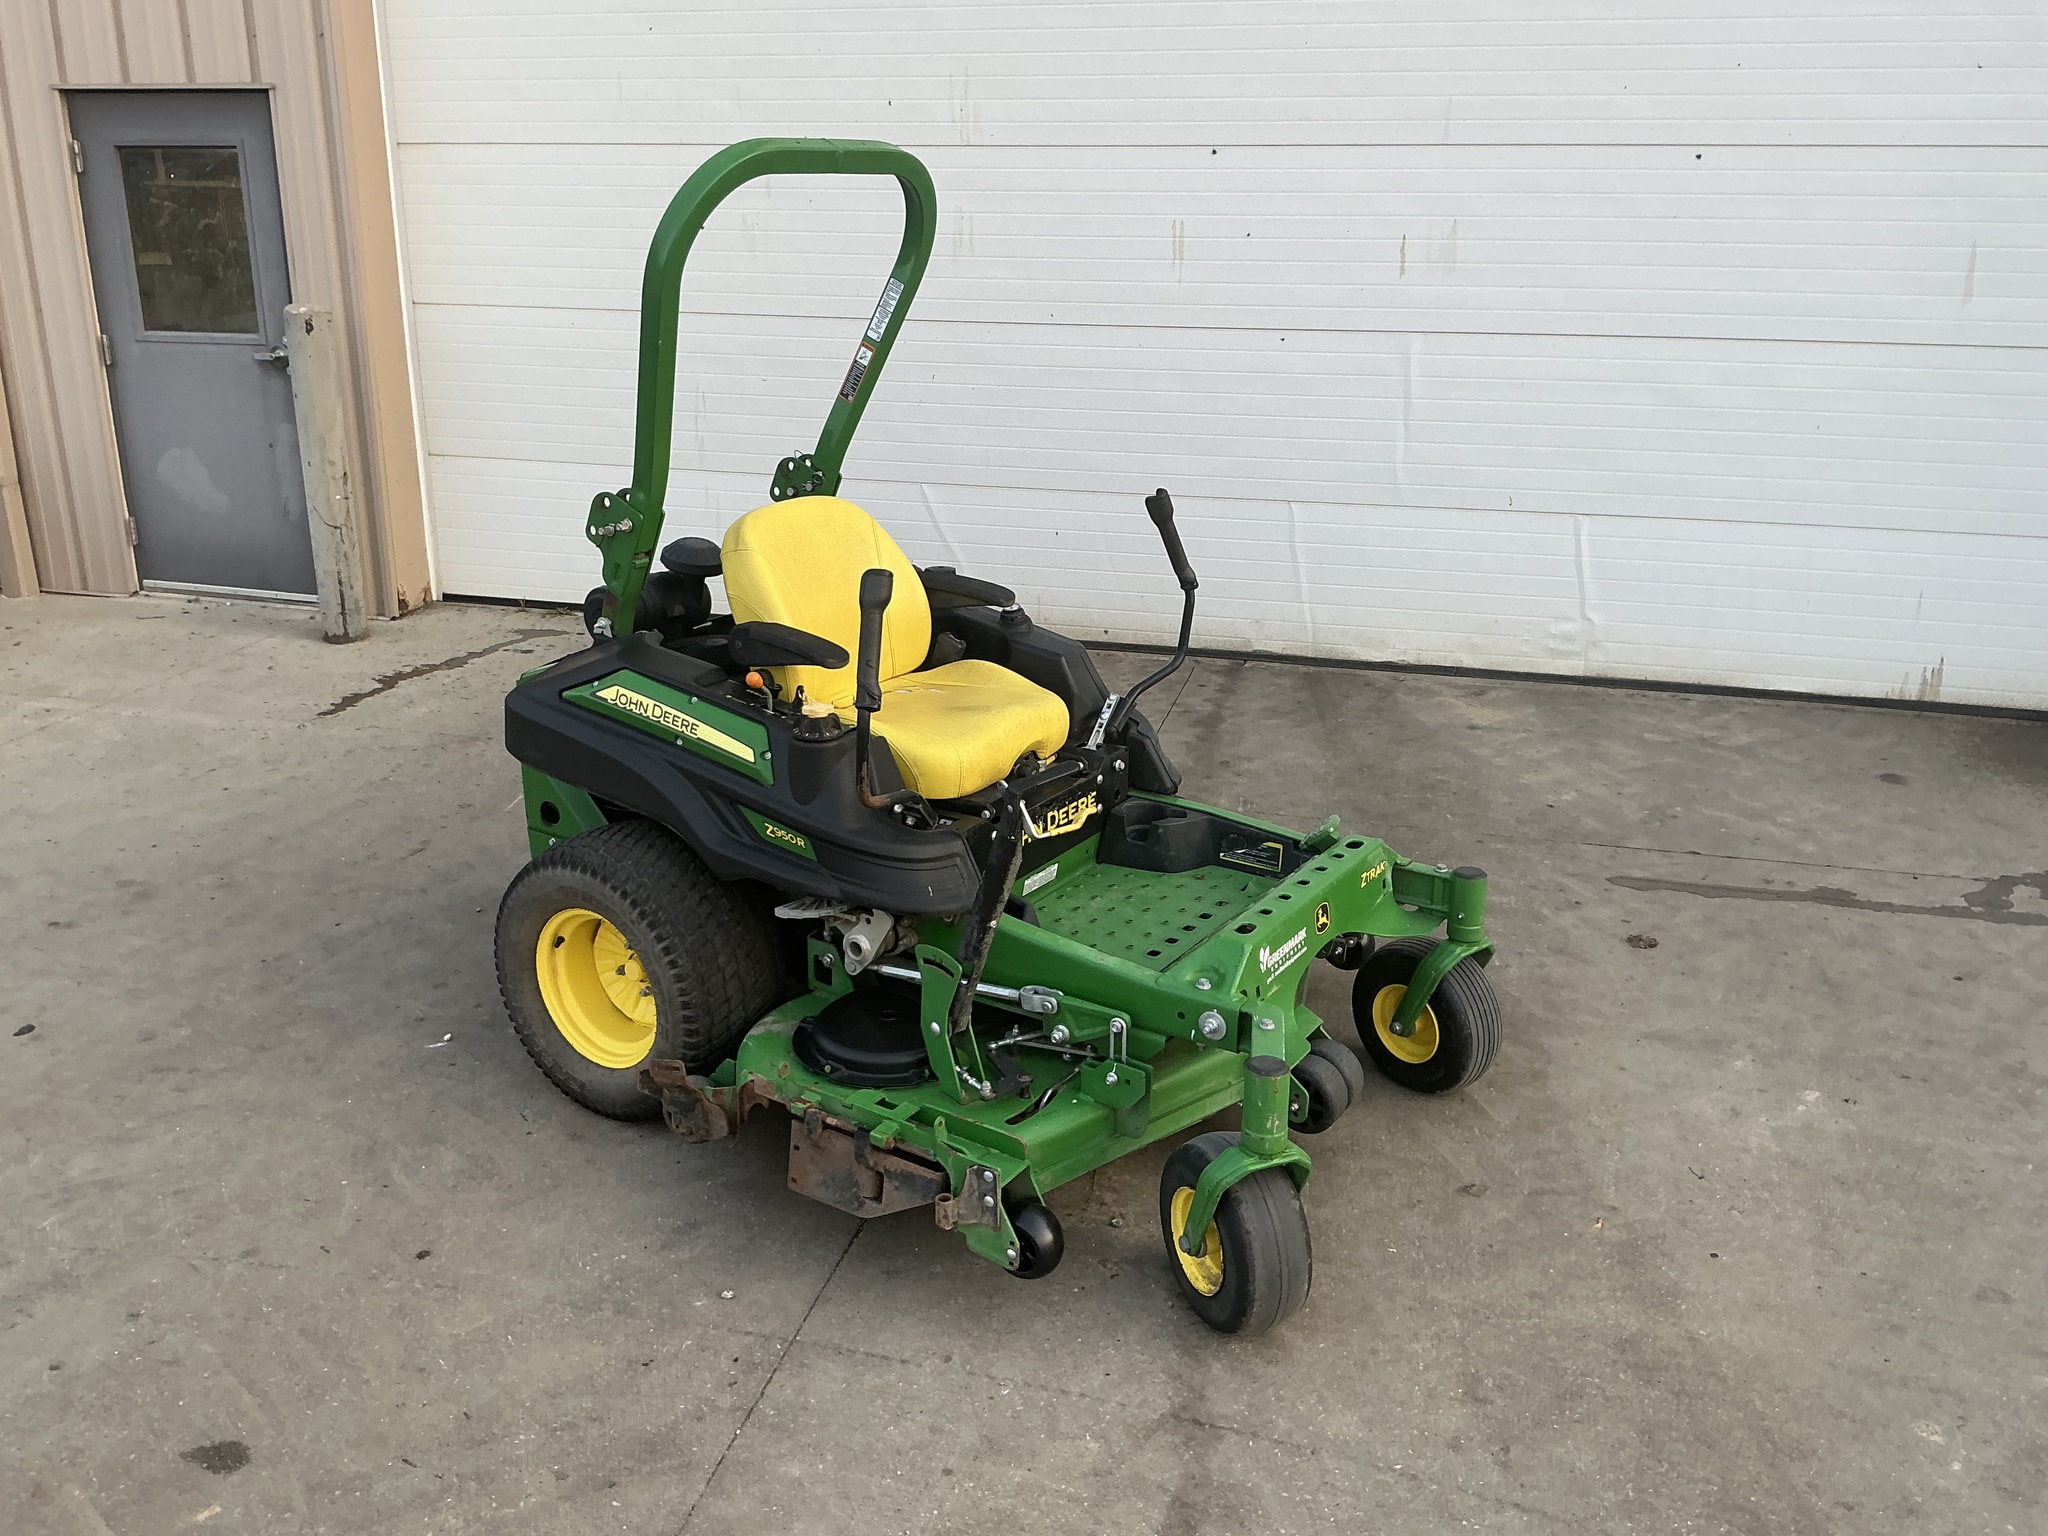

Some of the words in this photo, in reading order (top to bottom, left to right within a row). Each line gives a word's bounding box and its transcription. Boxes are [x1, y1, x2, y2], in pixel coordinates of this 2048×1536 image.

[610, 688, 649, 715] JOHN
[651, 704, 700, 737] DEERE
[1047, 790, 1097, 832] DEERE
[764, 822, 806, 849] Z950R
[1360, 860, 1387, 889] ZTRAK
[1267, 926, 1307, 969] GREENMARK
